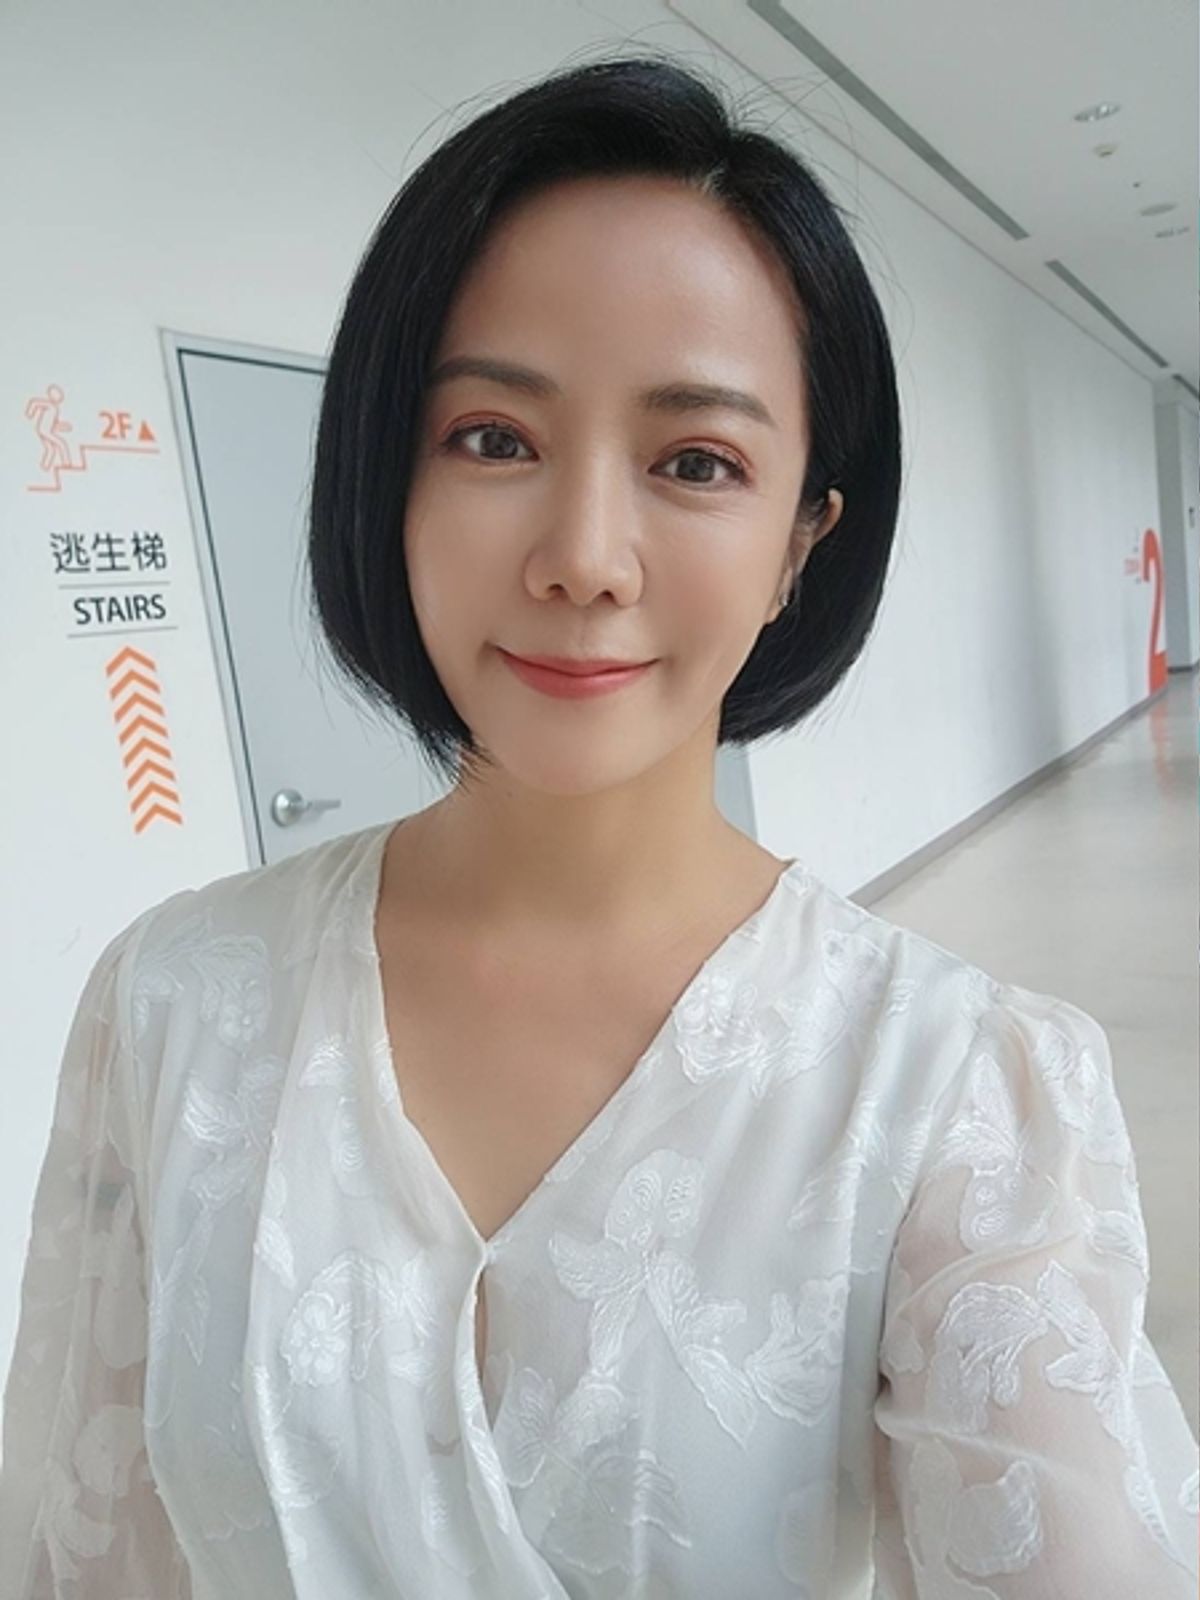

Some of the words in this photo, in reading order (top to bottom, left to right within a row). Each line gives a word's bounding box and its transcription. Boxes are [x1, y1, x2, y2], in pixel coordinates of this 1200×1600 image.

[100, 412, 131, 439] 2F
[50, 531, 167, 573] 逃生梯
[73, 594, 166, 625] STAIRS
